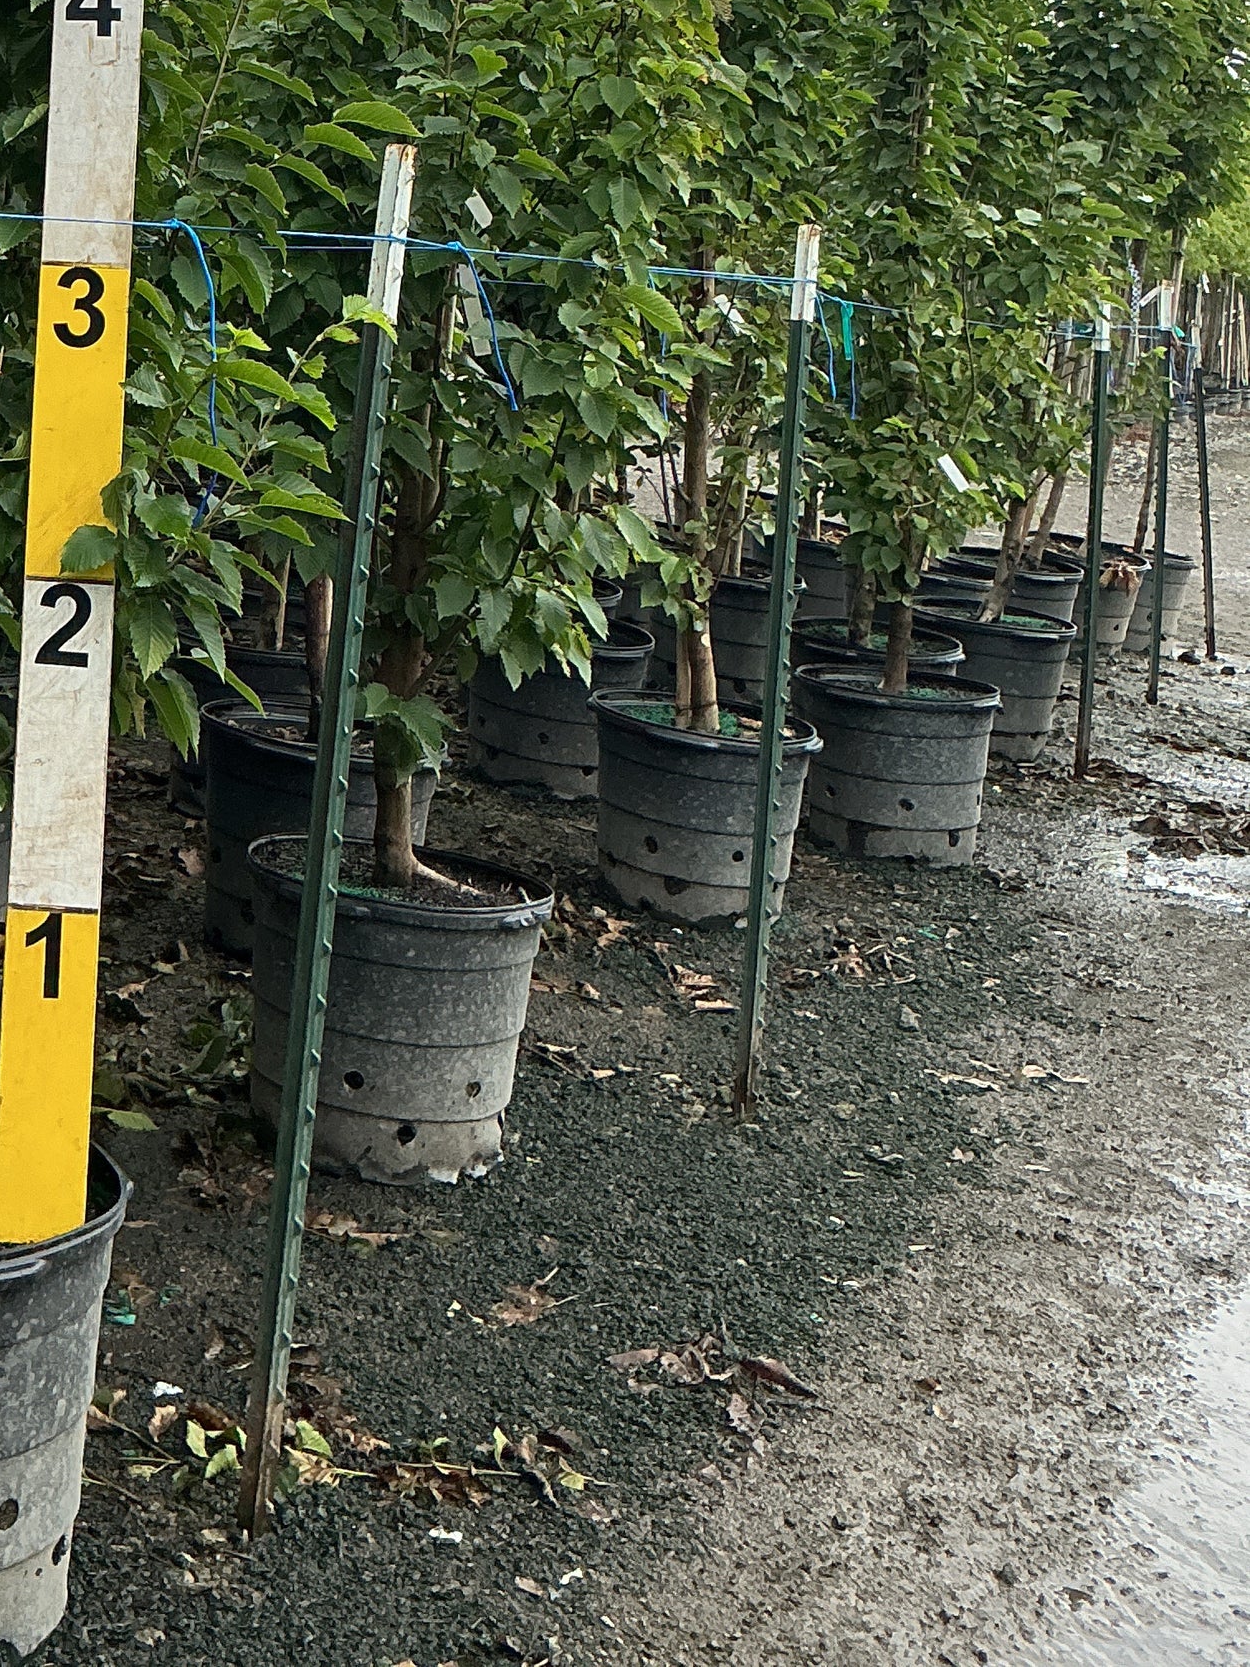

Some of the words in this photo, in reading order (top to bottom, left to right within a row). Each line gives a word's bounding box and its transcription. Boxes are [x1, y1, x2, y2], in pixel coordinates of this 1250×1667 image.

[53, 267, 105, 348] 3
[34, 583, 92, 668] 2
[25, 912, 62, 998] 1
